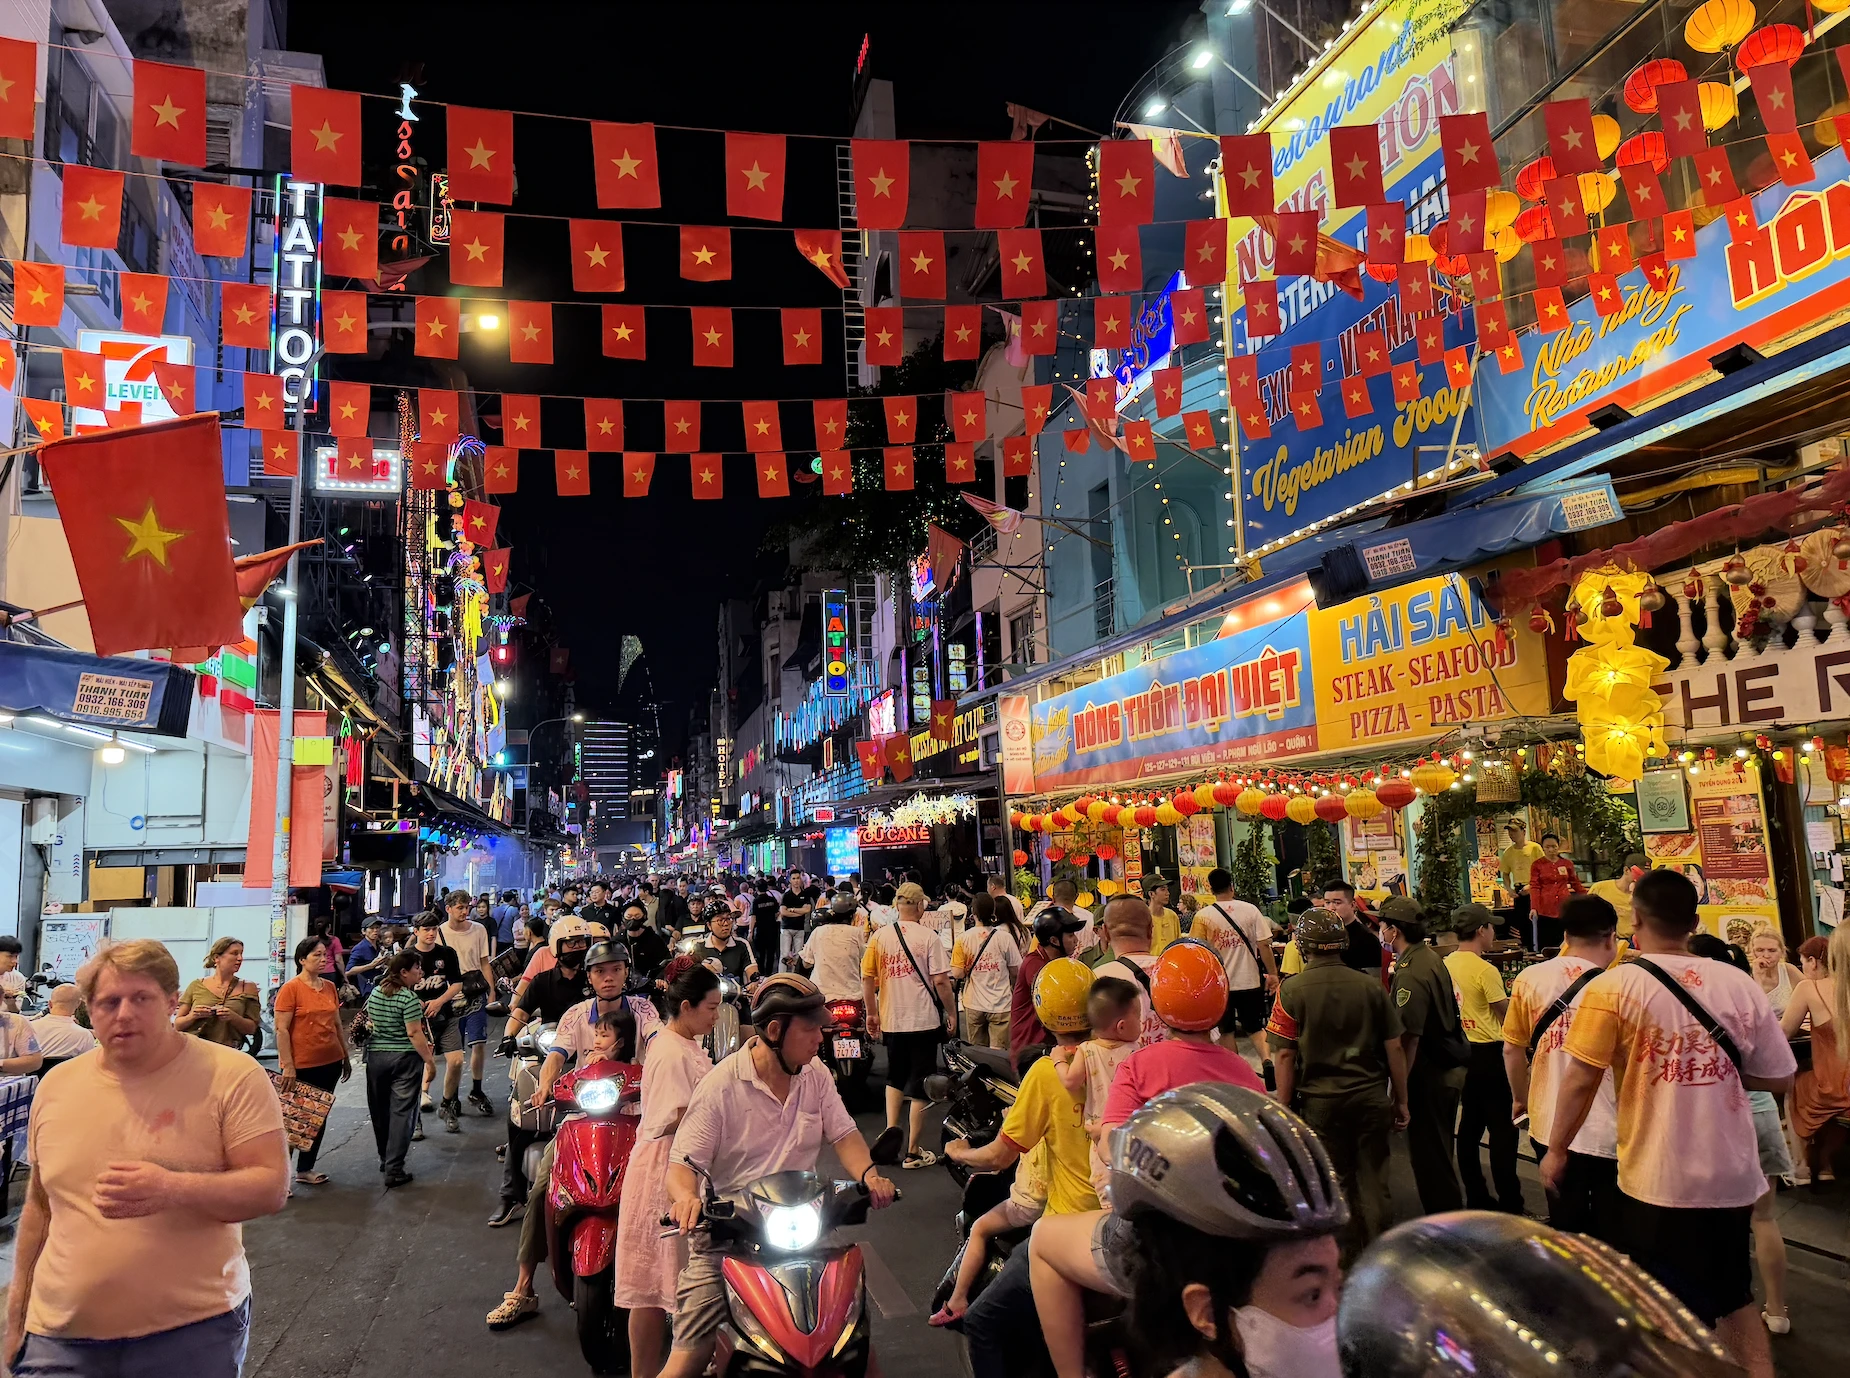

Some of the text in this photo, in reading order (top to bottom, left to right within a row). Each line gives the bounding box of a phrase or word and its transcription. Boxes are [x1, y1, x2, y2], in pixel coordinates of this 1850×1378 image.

[1272, 19, 1415, 177] estaurant
[278, 182, 316, 404] TATTOO
[1524, 304, 1693, 432] Restaurant
[1251, 425, 1385, 517] Vegetarian
[827, 602, 846, 690] TATTOO
[1339, 596, 1405, 664] HẢI
[79, 693, 146, 710] 0932.166.309
[80, 684, 117, 697] THANH
[1073, 700, 1124, 754] NÔNG
[1122, 679, 1183, 740] THÔN
[1230, 644, 1302, 721] VIỆT
[1332, 663, 1396, 704] STEAK
[1408, 639, 1517, 688] SEAFOOD
[76, 703, 144, 720] 0918.995.654
[1350, 702, 1411, 739] PIZZA
[1429, 683, 1506, 724] PASTA
[717, 746, 727, 788] HOTEL
